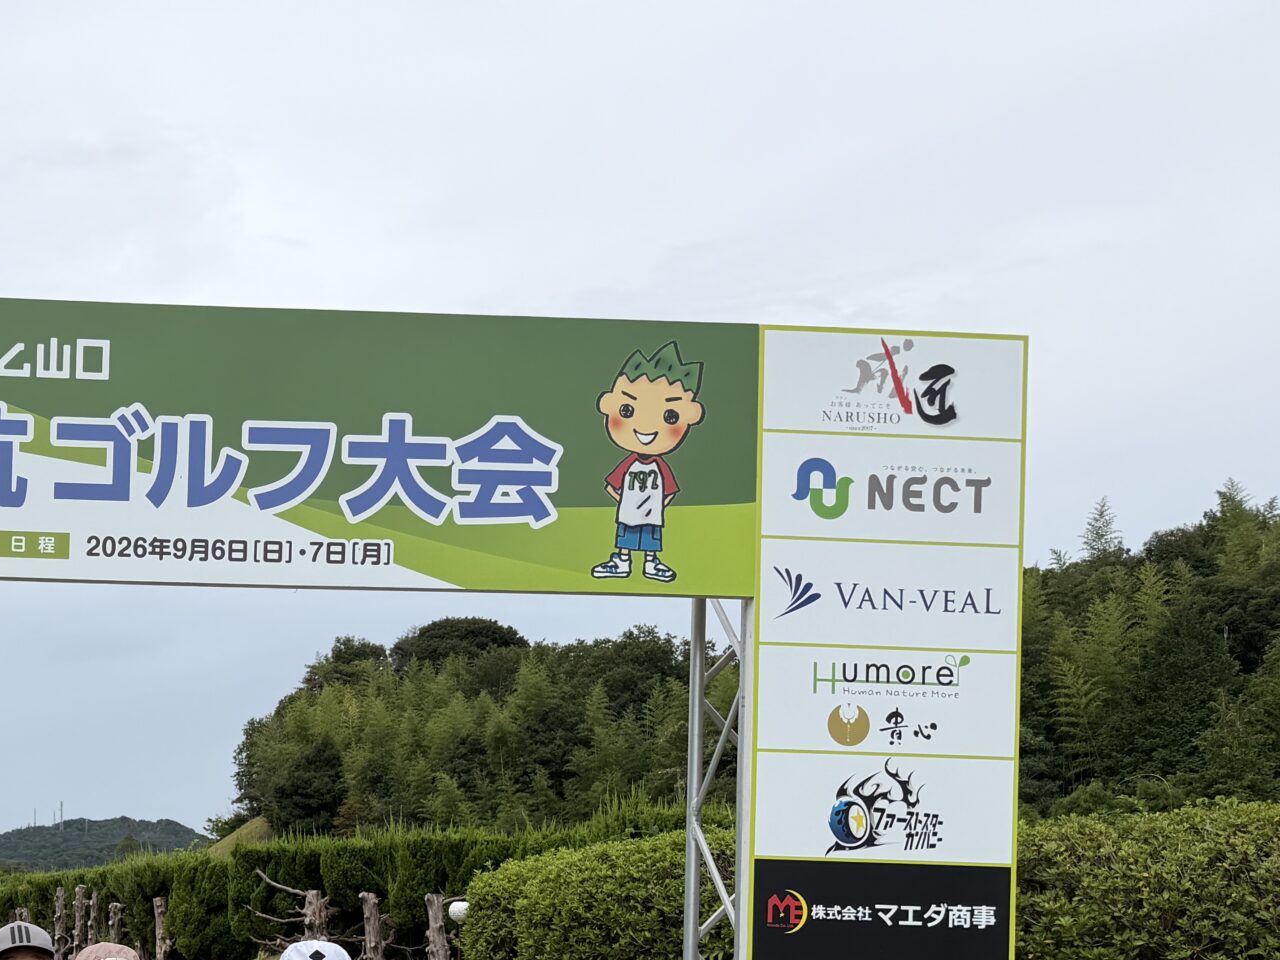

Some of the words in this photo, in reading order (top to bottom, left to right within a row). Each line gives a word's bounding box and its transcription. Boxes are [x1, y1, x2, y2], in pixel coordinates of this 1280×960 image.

[822, 410, 901, 424] NARUSHO
[867, 473, 992, 514] NECT
[11, 535, 55, 554] 日程
[834, 582, 1001, 615] VAN-VEAL
[813, 660, 959, 694] Humore
[843, 686, 881, 697] Human
[886, 688, 927, 698] Nature
[931, 689, 960, 699] More
